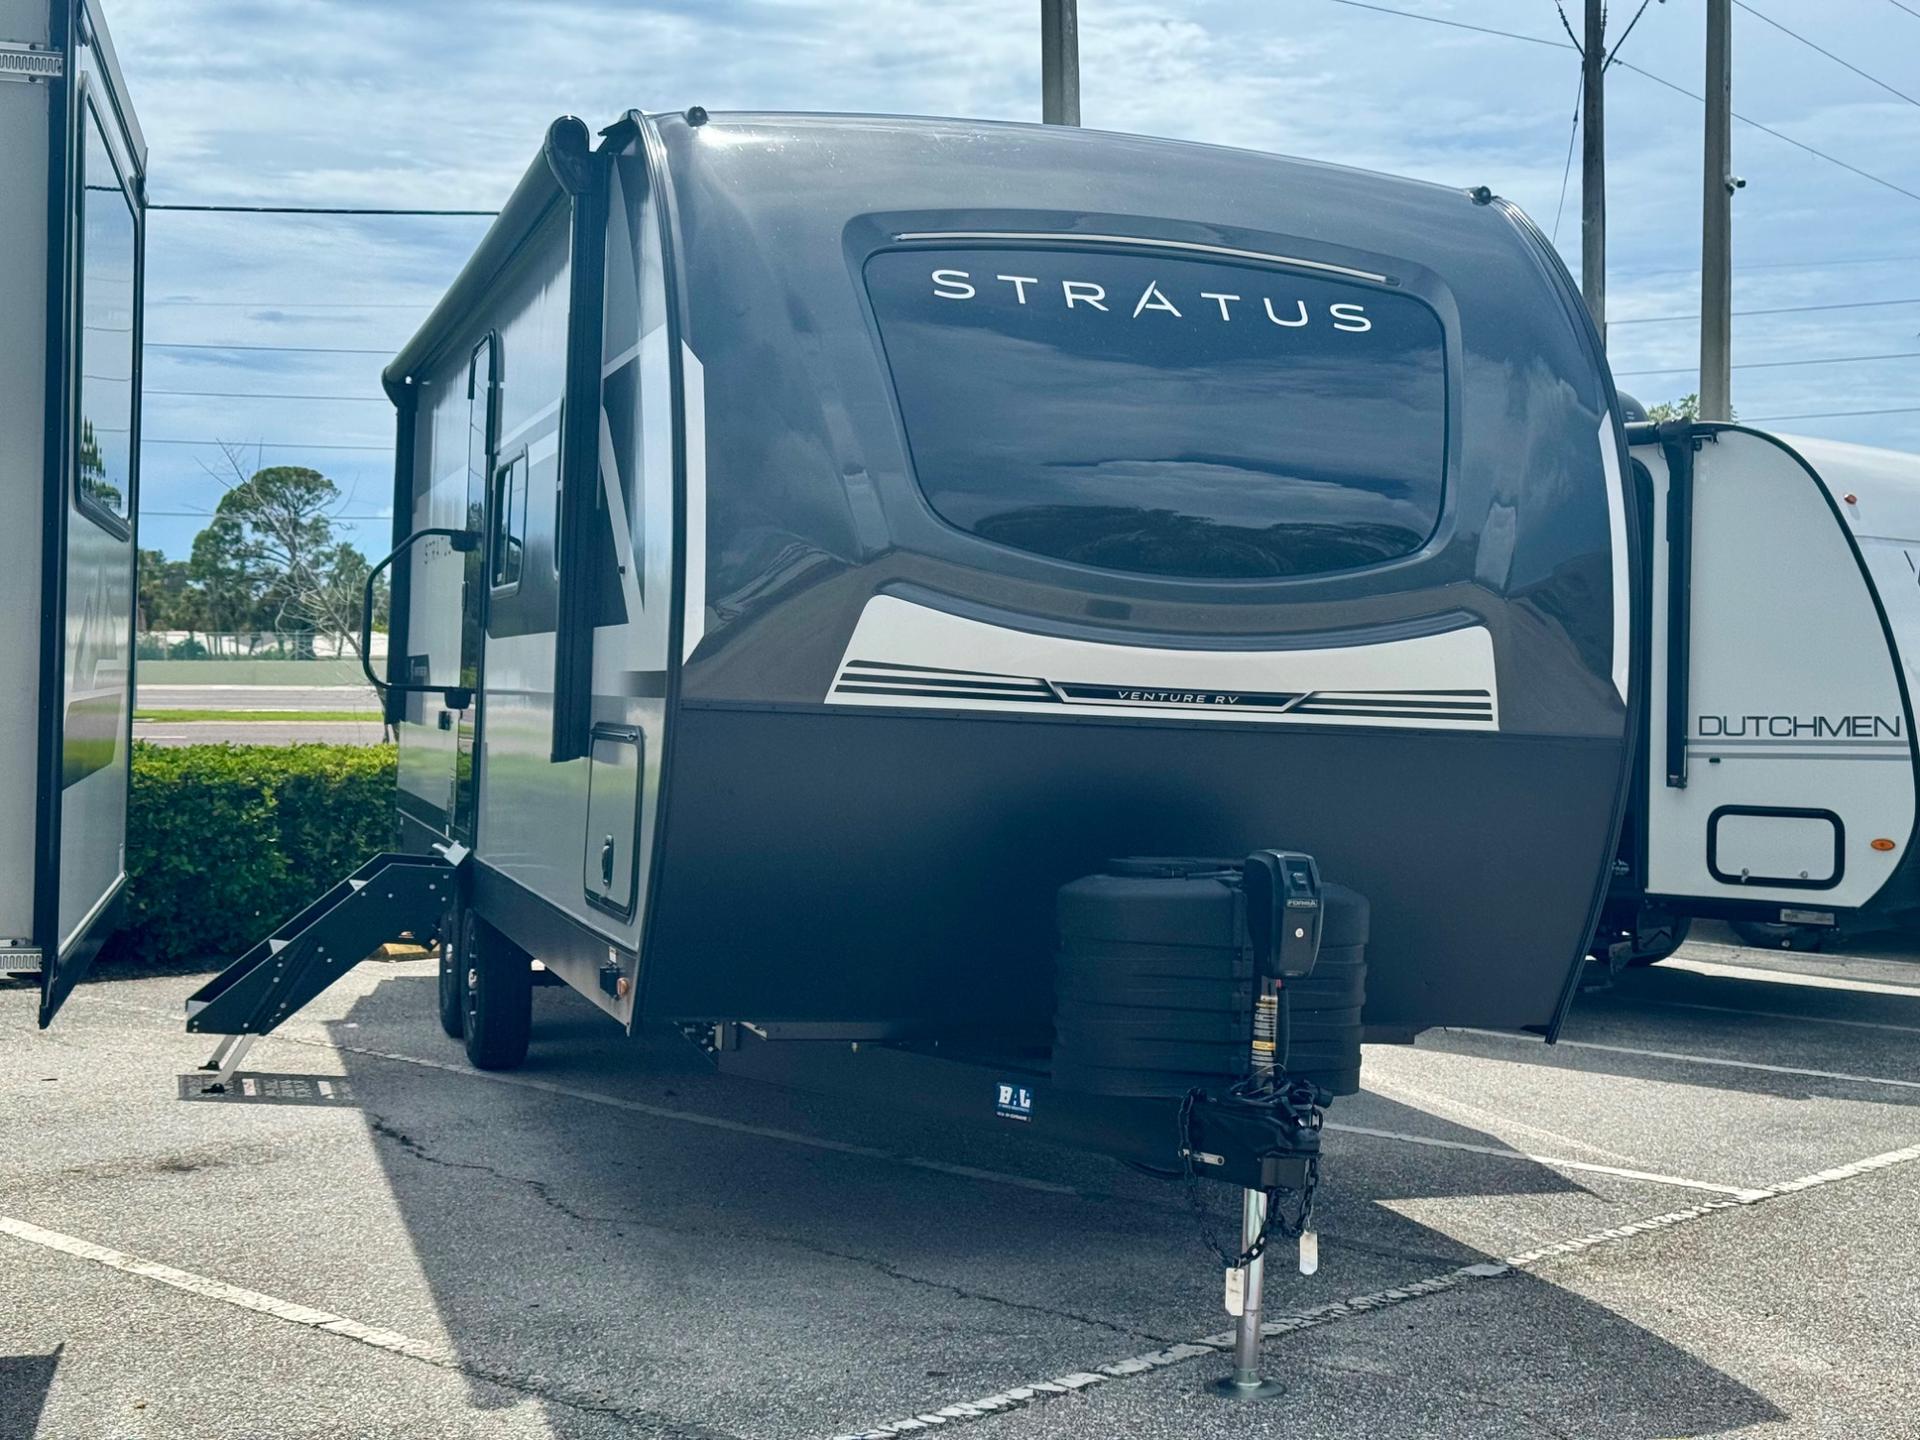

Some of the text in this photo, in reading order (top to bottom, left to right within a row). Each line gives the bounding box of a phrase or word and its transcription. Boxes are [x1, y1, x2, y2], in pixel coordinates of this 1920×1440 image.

[931, 269, 1373, 332] STRATUS
[1118, 691, 1239, 704] VENTURE RV
[1699, 716, 1900, 737] DUTCHMEN
